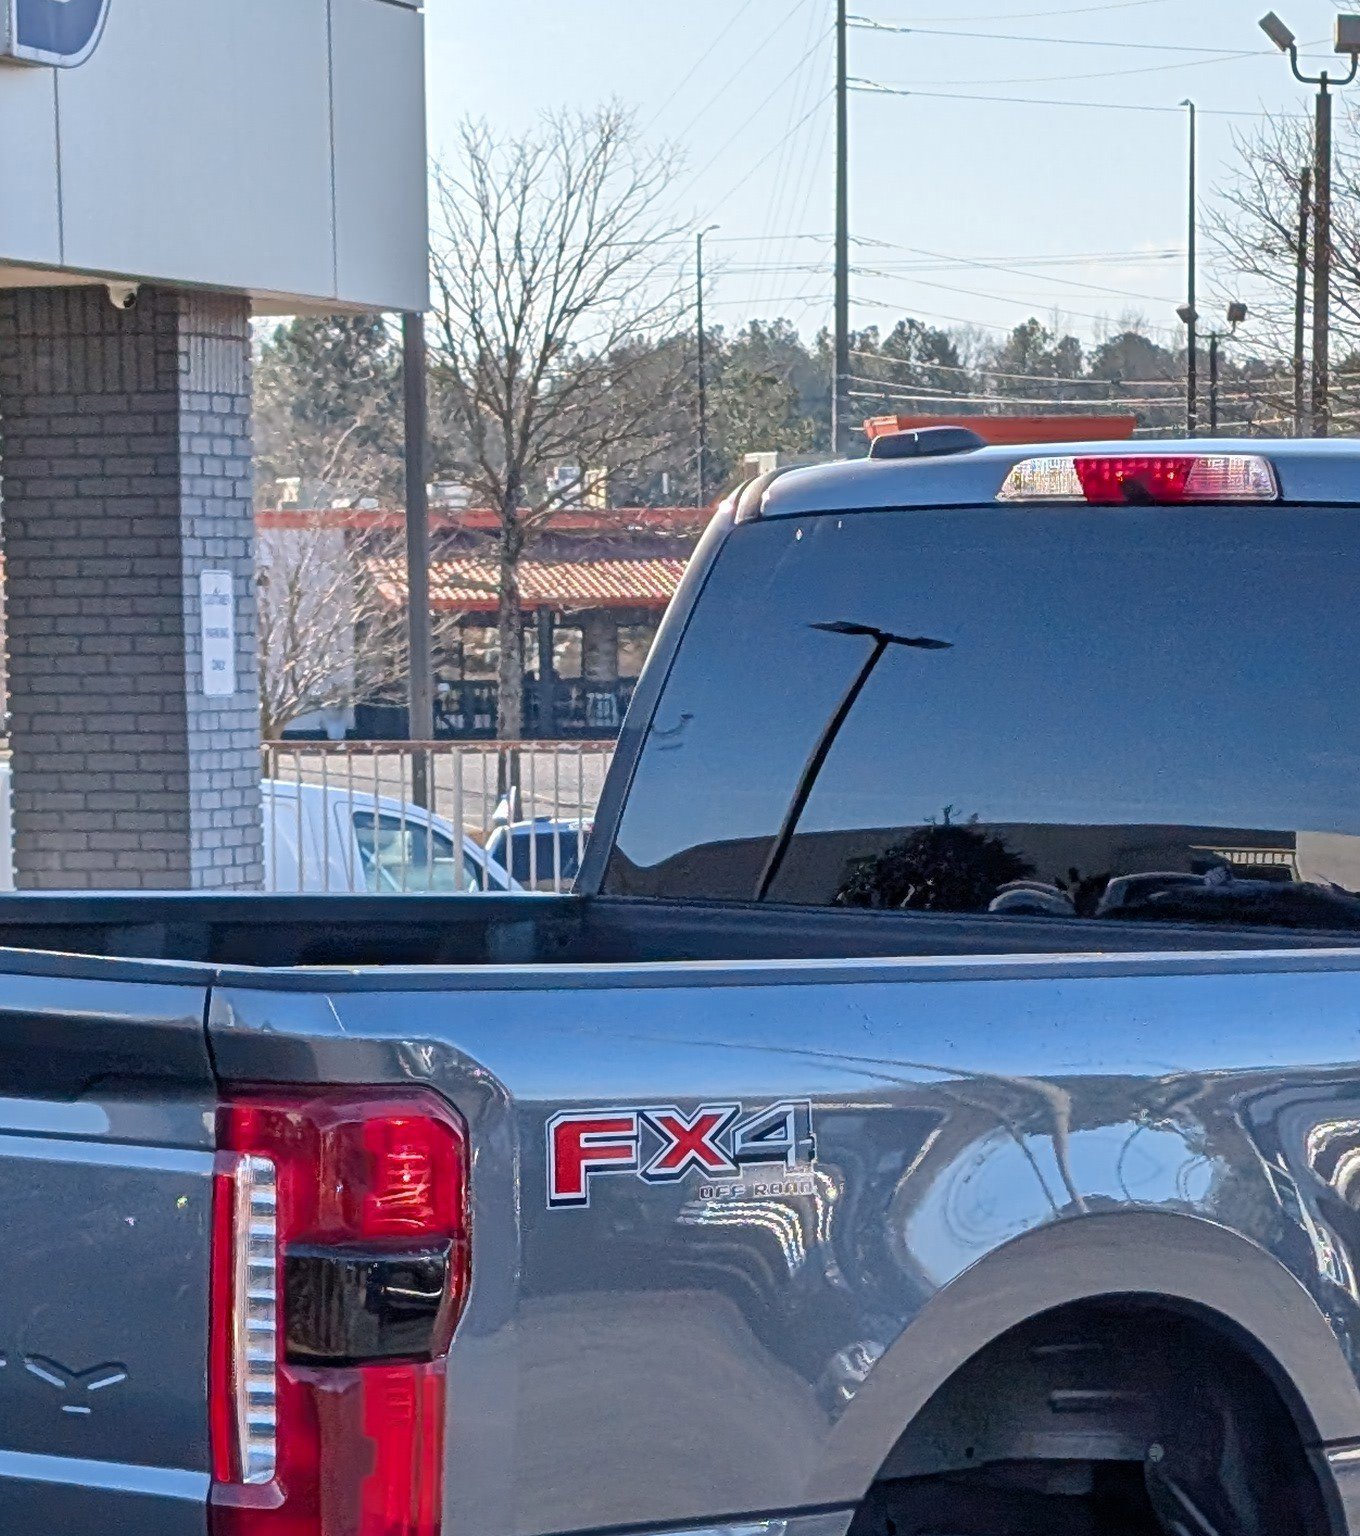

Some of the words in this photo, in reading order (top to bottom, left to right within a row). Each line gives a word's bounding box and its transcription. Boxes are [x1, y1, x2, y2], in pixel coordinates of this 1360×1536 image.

[545, 1098, 816, 1210] FX4
[698, 1184, 746, 1201] OFF
[752, 1179, 815, 1198] ROAD
